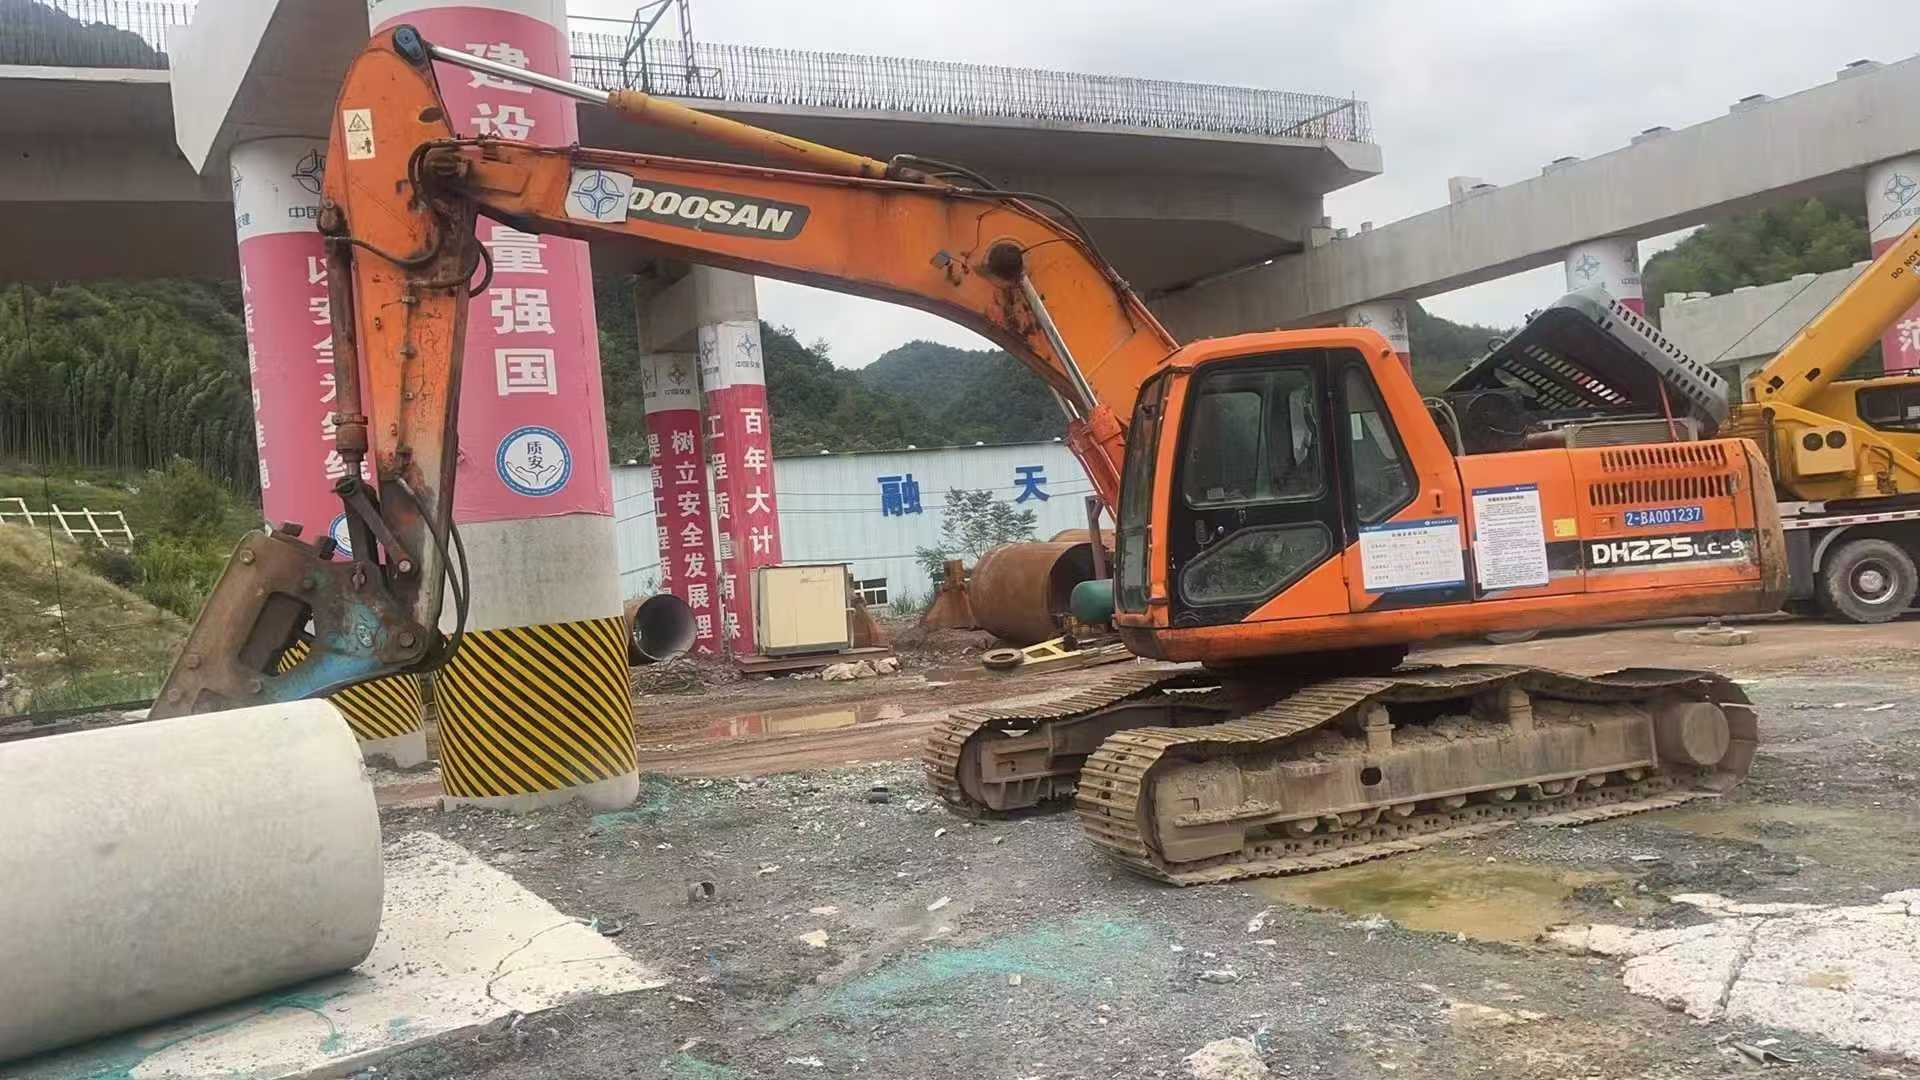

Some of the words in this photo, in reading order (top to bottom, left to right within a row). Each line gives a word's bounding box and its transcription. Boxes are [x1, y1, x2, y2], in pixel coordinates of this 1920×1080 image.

[464, 43, 558, 396] 建设量强国
[629, 186, 793, 233] DOOSAN
[1891, 267, 1904, 279] DO
[526, 440, 544, 469] 质安
[740, 407, 773, 554] 百年大计
[877, 473, 923, 517] 融
[1014, 465, 1050, 504] 天
[1625, 507, 1701, 527] 2-BA001237
